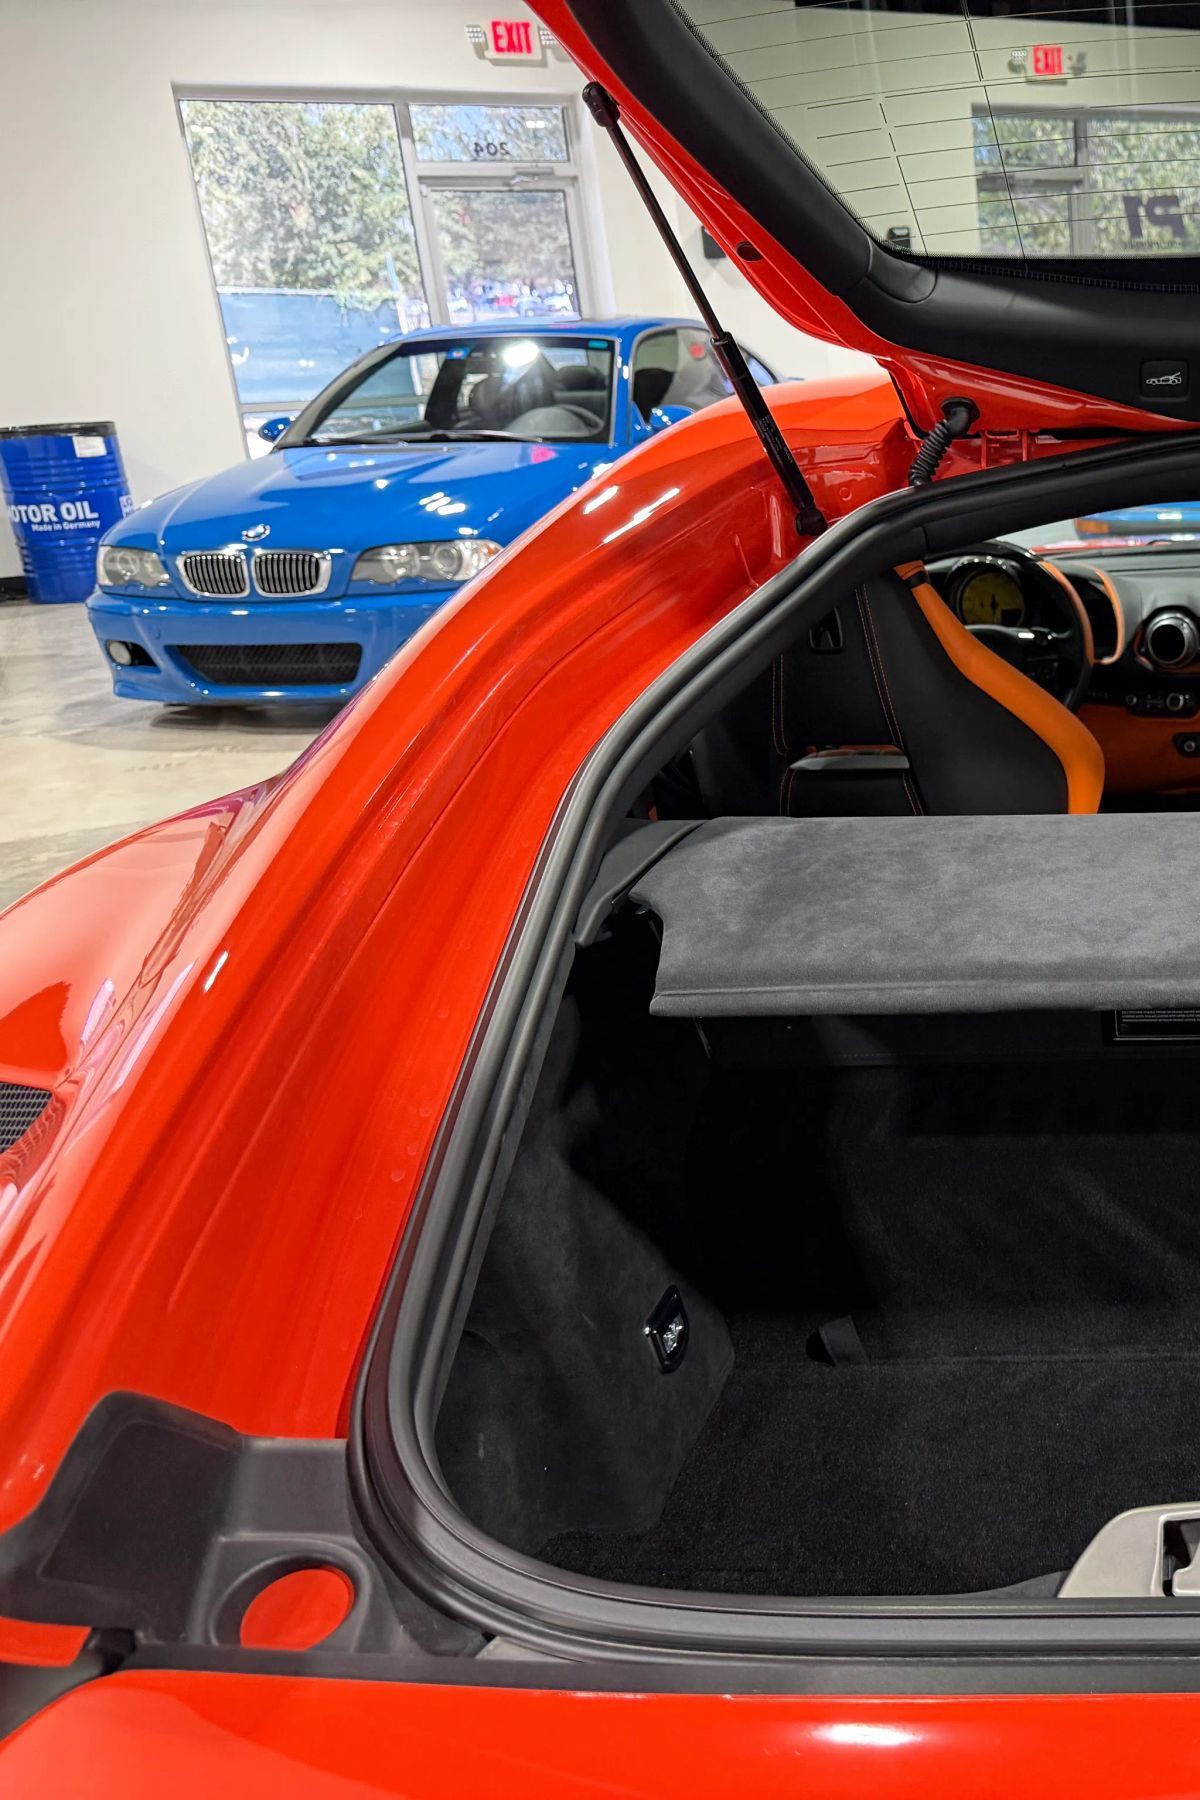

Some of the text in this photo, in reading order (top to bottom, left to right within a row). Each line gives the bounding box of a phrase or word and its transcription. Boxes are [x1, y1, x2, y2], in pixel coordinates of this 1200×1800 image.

[491, 20, 533, 54] EXIT
[60, 501, 99, 521] OIL
[31, 519, 101, 533] Made in Germany
